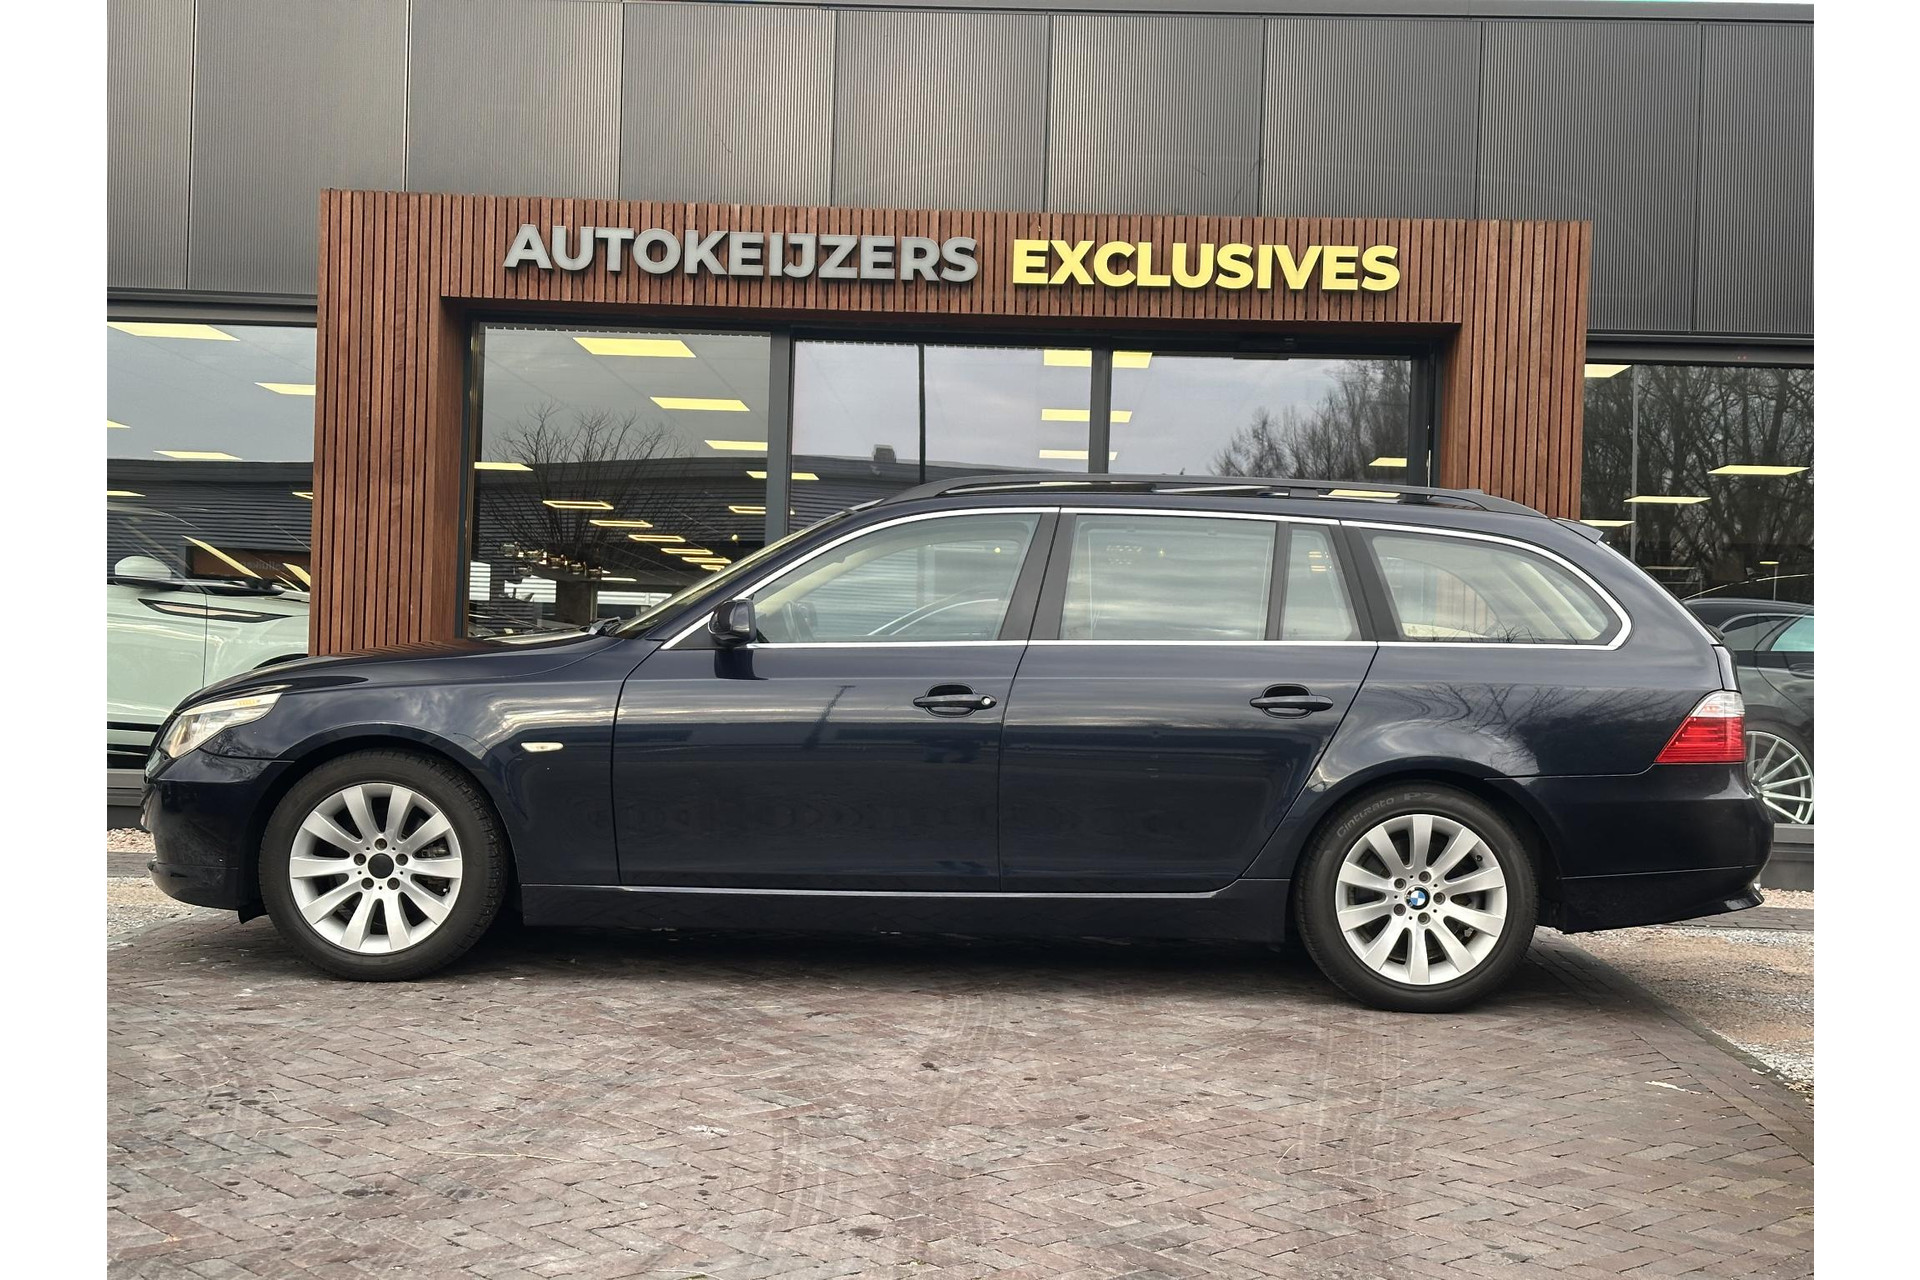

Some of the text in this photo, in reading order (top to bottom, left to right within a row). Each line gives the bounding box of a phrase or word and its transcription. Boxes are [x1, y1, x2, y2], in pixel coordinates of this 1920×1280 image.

[503, 223, 1401, 292] AUTOKEIJZERS EXCLUSIVES
[1403, 792, 1441, 801] P7
